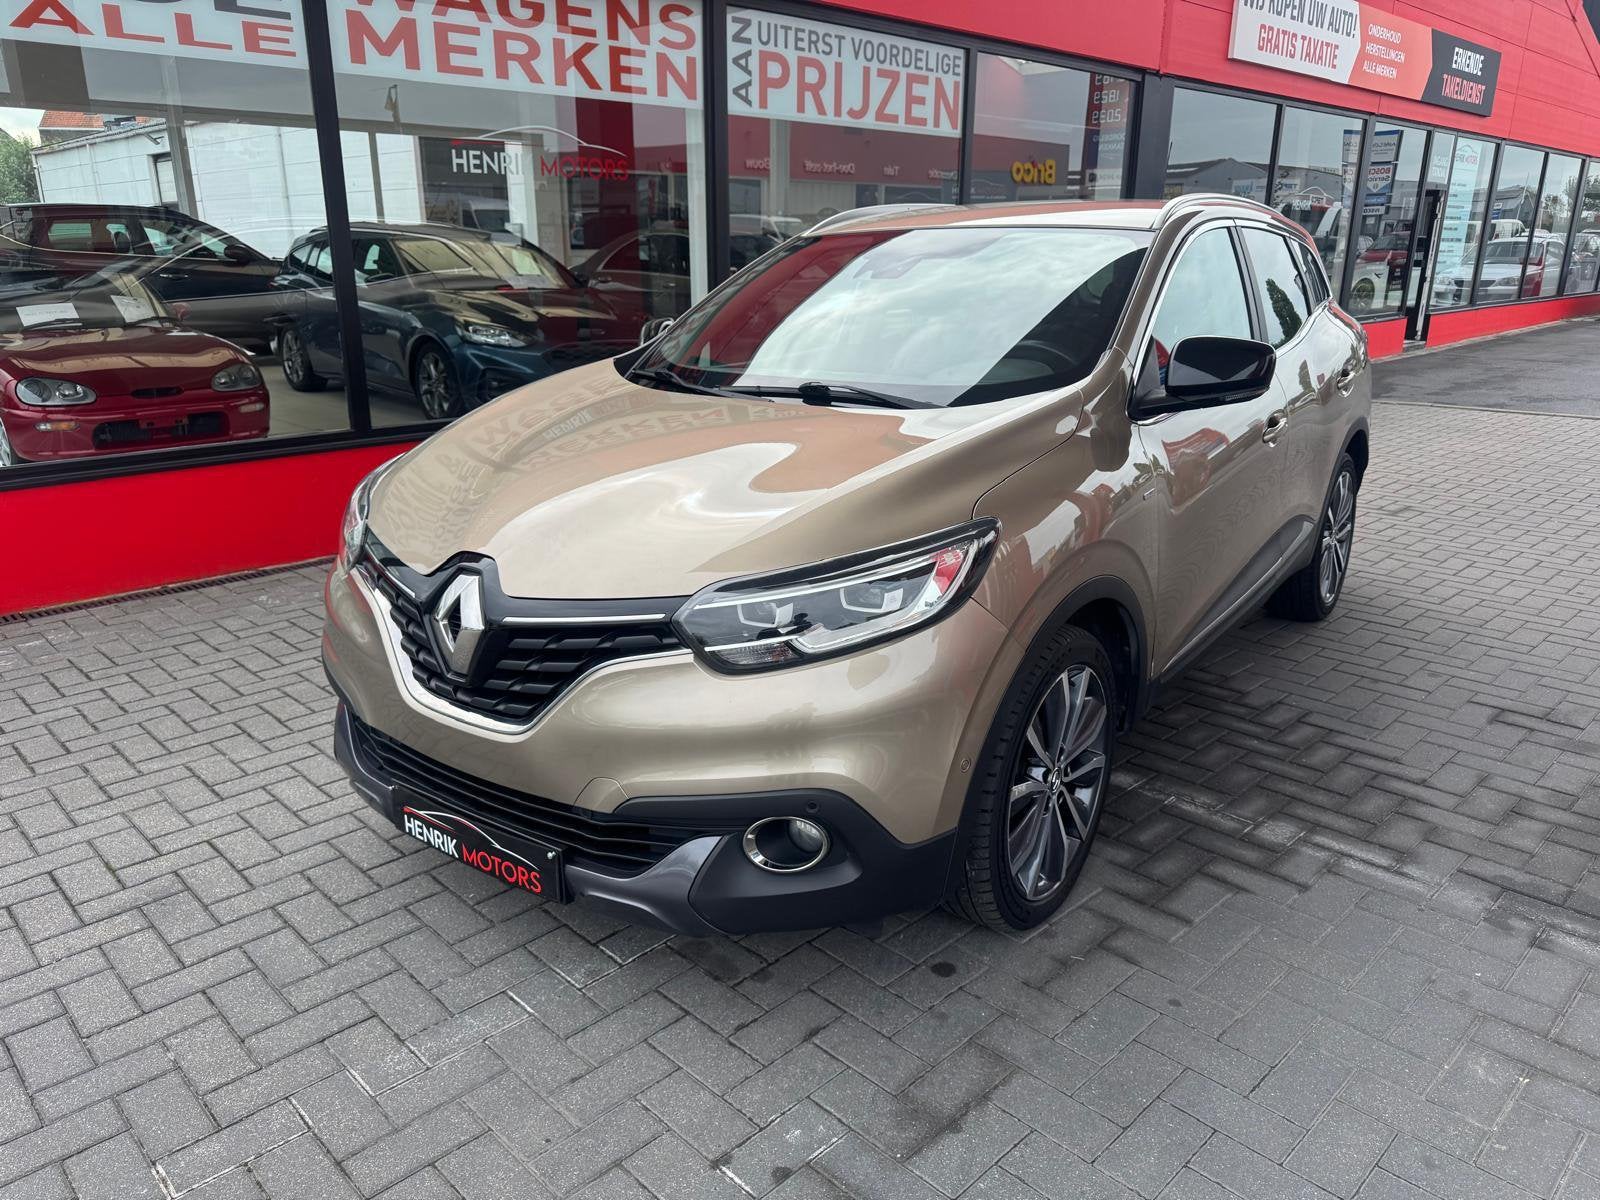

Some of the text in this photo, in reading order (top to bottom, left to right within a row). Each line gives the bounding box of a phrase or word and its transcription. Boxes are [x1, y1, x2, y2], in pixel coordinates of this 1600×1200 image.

[8, 0, 297, 57] ALLE
[349, 0, 697, 50] GENS
[1307, 0, 1328, 29] UW
[1327, 6, 1358, 39] AUTO!
[1367, 23, 1402, 44] ONDERHOUD
[345, 9, 698, 100] MERKEN
[731, 15, 752, 108] AAN
[757, 20, 962, 77] UITERST VOORDELIGE
[1257, 23, 1340, 70] GRATIS TAXATIE
[1362, 60, 1398, 79] ALLE MERKEN
[1365, 41, 1406, 64] HERSTELLINGEN
[1451, 46, 1485, 76] ERKENDE
[758, 49, 960, 130] PRIJZEN
[1441, 73, 1486, 105] TAKELDIENST
[451, 148, 630, 181] HENRI MOTORS
[404, 813, 542, 895] HENRIK MOTORS
